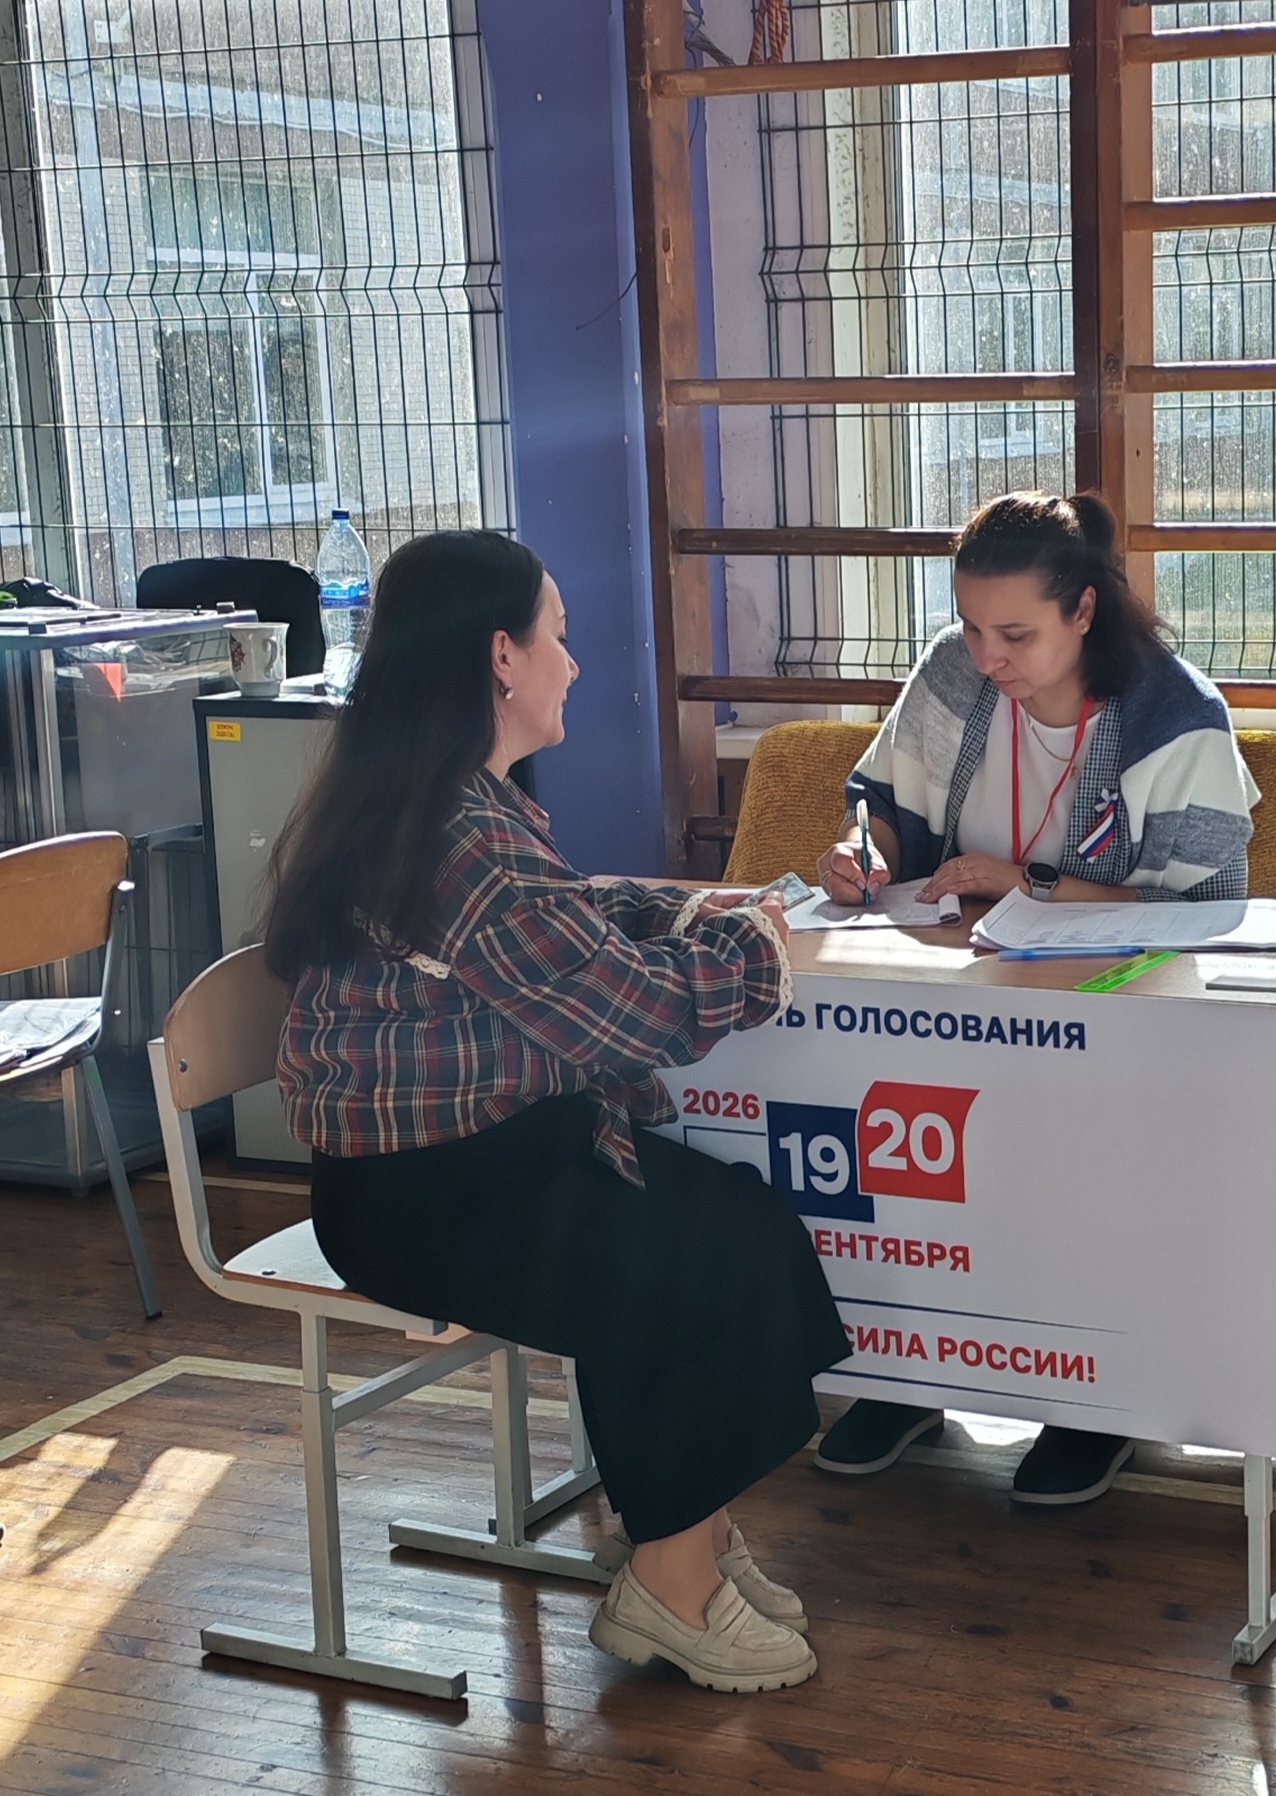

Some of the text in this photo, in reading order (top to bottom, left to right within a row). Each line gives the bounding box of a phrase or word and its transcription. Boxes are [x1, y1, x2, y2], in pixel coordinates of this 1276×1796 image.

[815, 1003, 1086, 1051] ГОЛОСОВАНИЯ
[683, 1088, 761, 1120] 2026
[778, 1107, 956, 1196] 19 20
[811, 1228, 971, 1273] ЕНТЯБРЯ
[937, 1335, 1096, 1384] РОССИИ!
